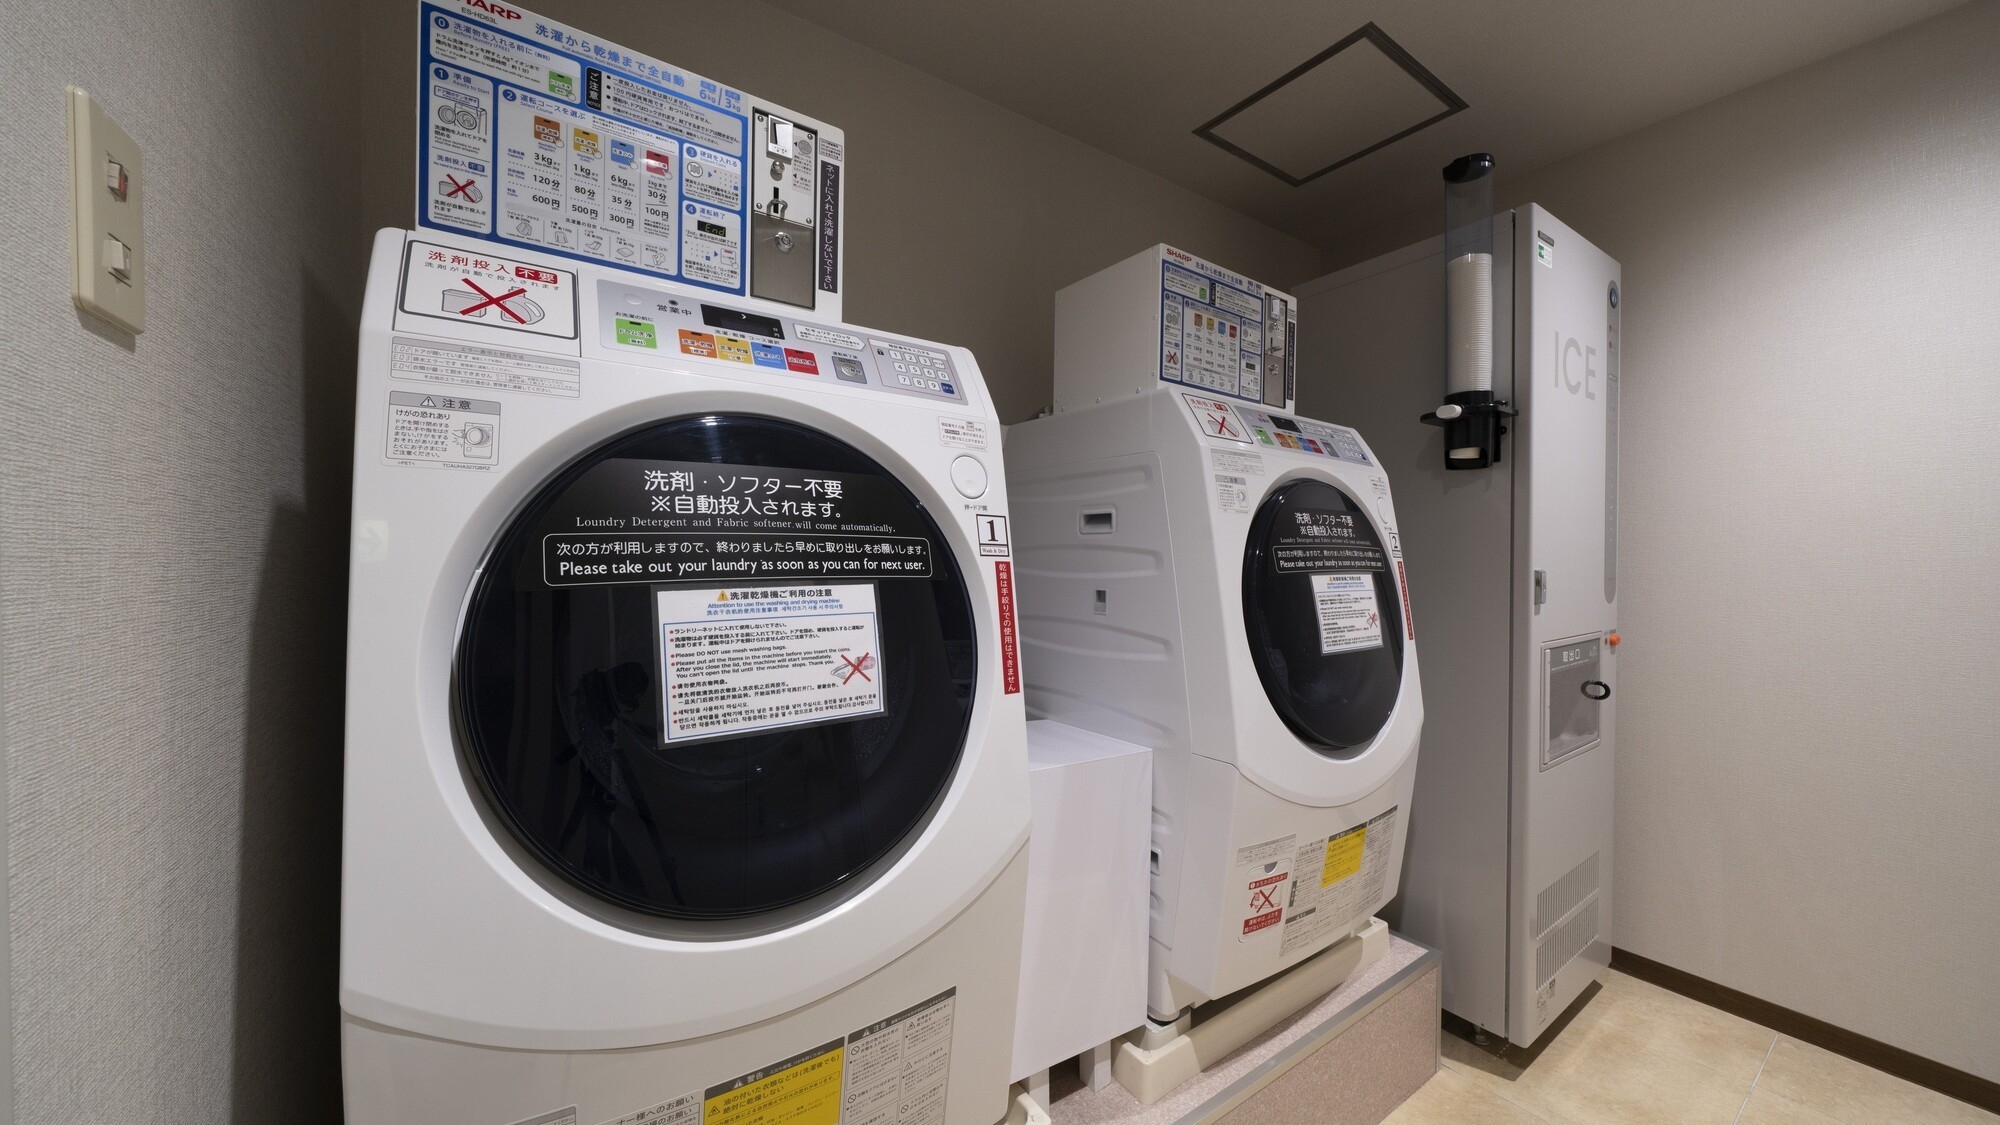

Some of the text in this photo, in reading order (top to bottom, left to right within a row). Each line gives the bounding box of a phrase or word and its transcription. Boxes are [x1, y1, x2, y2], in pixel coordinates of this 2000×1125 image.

[454, 22, 533, 56] 洗濯物を入れる前に
[536, 22, 685, 88] 洗濯から乾燥まで全自動
[453, 72, 472, 84] 準備
[453, 80, 470, 90] Ready
[589, 72, 599, 100] ご注意
[520, 94, 586, 120] 運転コースを選ぶ
[520, 102, 553, 114] Select Course
[436, 154, 466, 168] 洗剤投入
[700, 150, 738, 168] 硬貨を入れる
[533, 174, 560, 188] 120分
[574, 185, 596, 198] 80分
[648, 190, 667, 201] 30分
[434, 200, 486, 215] 洗剤が自動で投入さ
[532, 194, 560, 208] 600円
[612, 196, 632, 207] 35分
[572, 204, 598, 218] 500円
[645, 206, 669, 220] 100円
[700, 208, 725, 219] 運転終了
[609, 214, 634, 227] 300円
[824, 164, 835, 290] ネットに入れて洗濯しないで下さい
[705, 224, 725, 236] End
[1166, 248, 1192, 262] SHARP
[428, 250, 555, 284] 洗剤投入 不要
[424, 261, 560, 291] 洗剤が自動で投入されます
[616, 312, 654, 322] お洗濯の前に
[657, 304, 692, 316] 営業中
[619, 328, 652, 338] ドラム洗浄
[1554, 331, 1596, 400] ICE
[442, 398, 471, 410] 注意
[396, 409, 450, 420] けがの恐れあり
[395, 419, 450, 428] ドアを開け閉めする
[393, 444, 447, 452] とくにお子さまには
[394, 438, 448, 446] おそれがあります。
[644, 470, 843, 499] 洗剤・ソフター不要
[651, 494, 841, 518] ※自動投入されます。
[576, 517, 626, 528] Loundry
[632, 517, 687, 528] Detergent
[693, 518, 712, 527] and
[717, 518, 748, 527] Fabric
[754, 518, 792, 528] softener
[795, 521, 812, 530] will
[841, 523, 896, 534] automatically.
[1294, 512, 1354, 526] 洗剤・ソフター不要
[986, 520, 998, 542] 1
[556, 541, 926, 556] 次の方が利用しますので、終わりましたら早めに取り出しをお願いします。
[1392, 535, 1398, 548] 2
[560, 558, 925, 576] Please take out your laundry as soon as you can for next user.
[1324, 559, 1338, 568] laundry
[730, 589, 832, 600] 洗濯乾燥機ご利用の注意
[675, 623, 787, 634] ランドリーネットに入れて使用しないで下さい。
[998, 564, 1016, 692] 乾燥は手絞りでの使用はできません
[873, 1022, 887, 1032] 注意
[724, 1054, 840, 1106] 油の付いた衣類などは(洗濯後でも)
[747, 1072, 764, 1083] 警告
[723, 1086, 784, 1114] 絶対に乾燥しない
